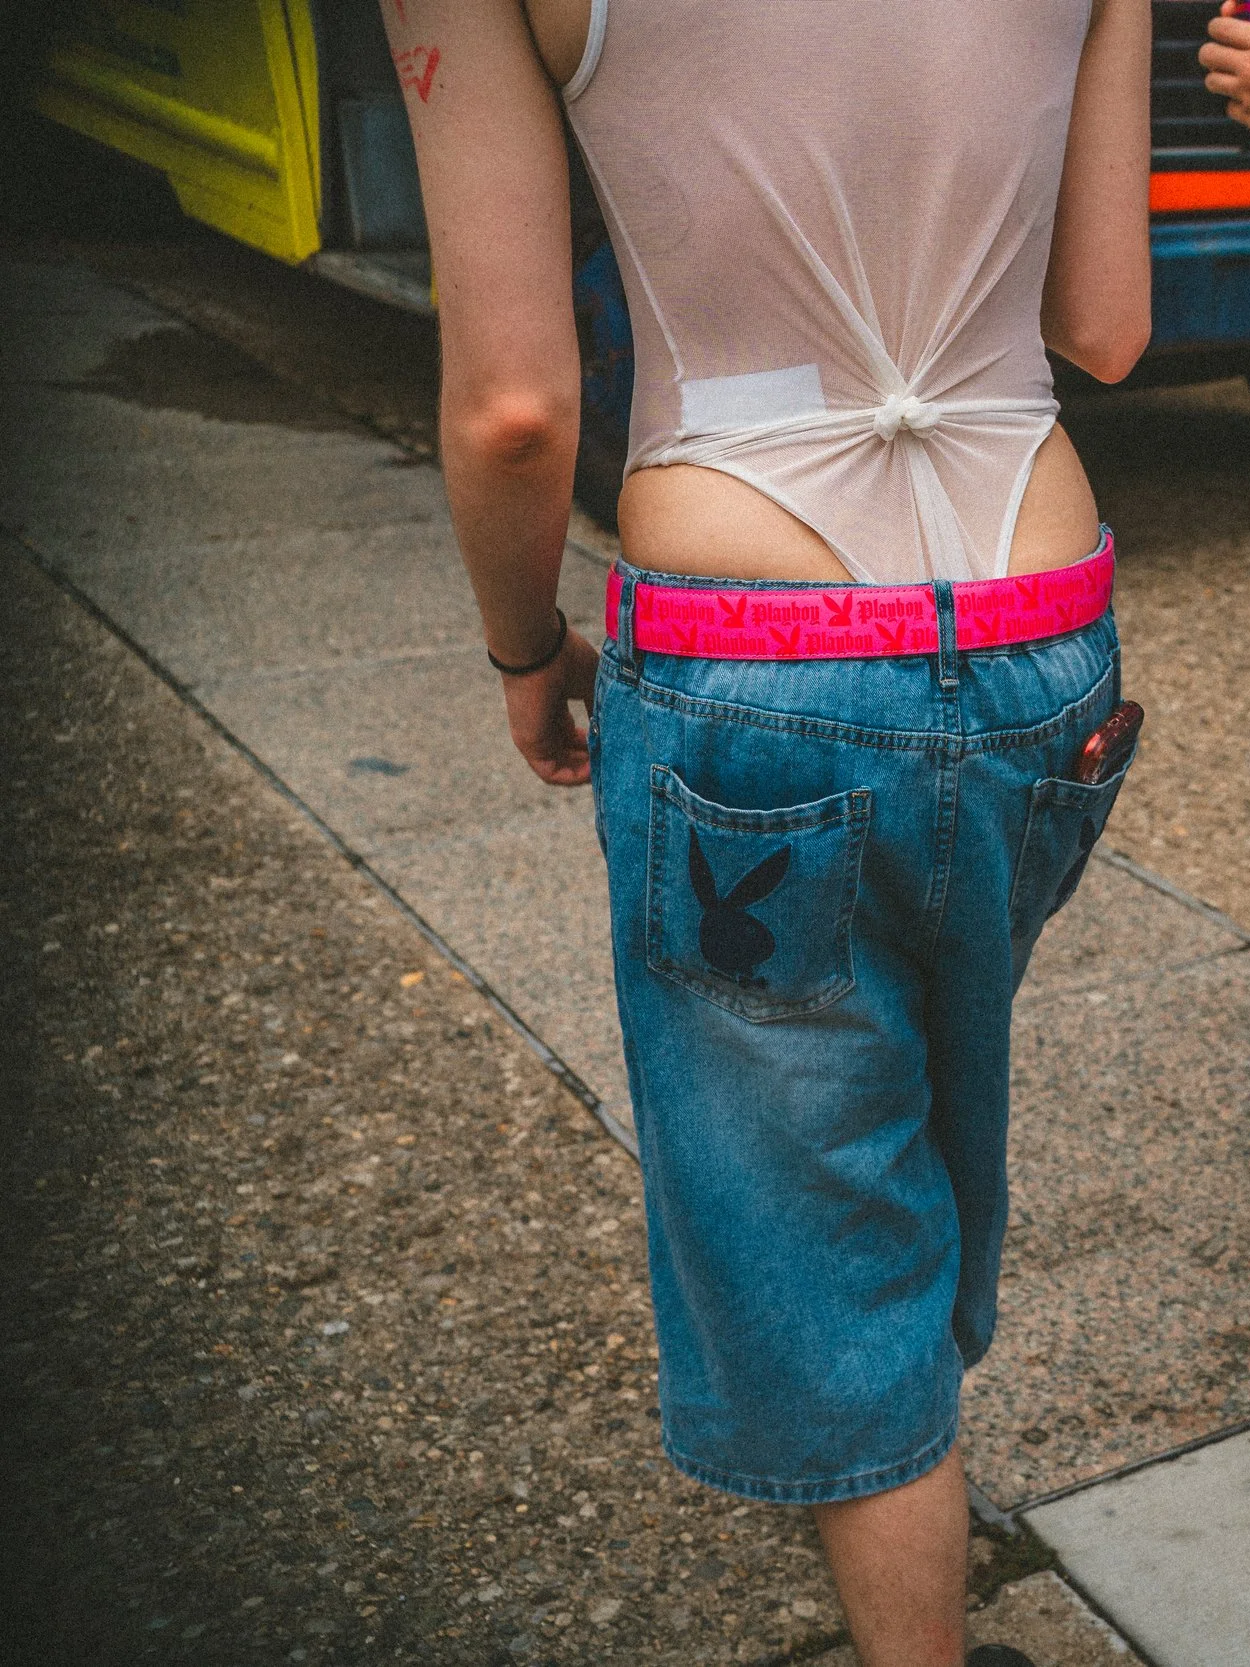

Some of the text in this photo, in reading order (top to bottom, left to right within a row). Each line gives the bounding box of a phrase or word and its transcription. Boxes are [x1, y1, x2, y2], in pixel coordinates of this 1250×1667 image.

[657, 599, 715, 624] Playboy
[752, 601, 820, 628] Playboy
[857, 598, 924, 625] Playboy
